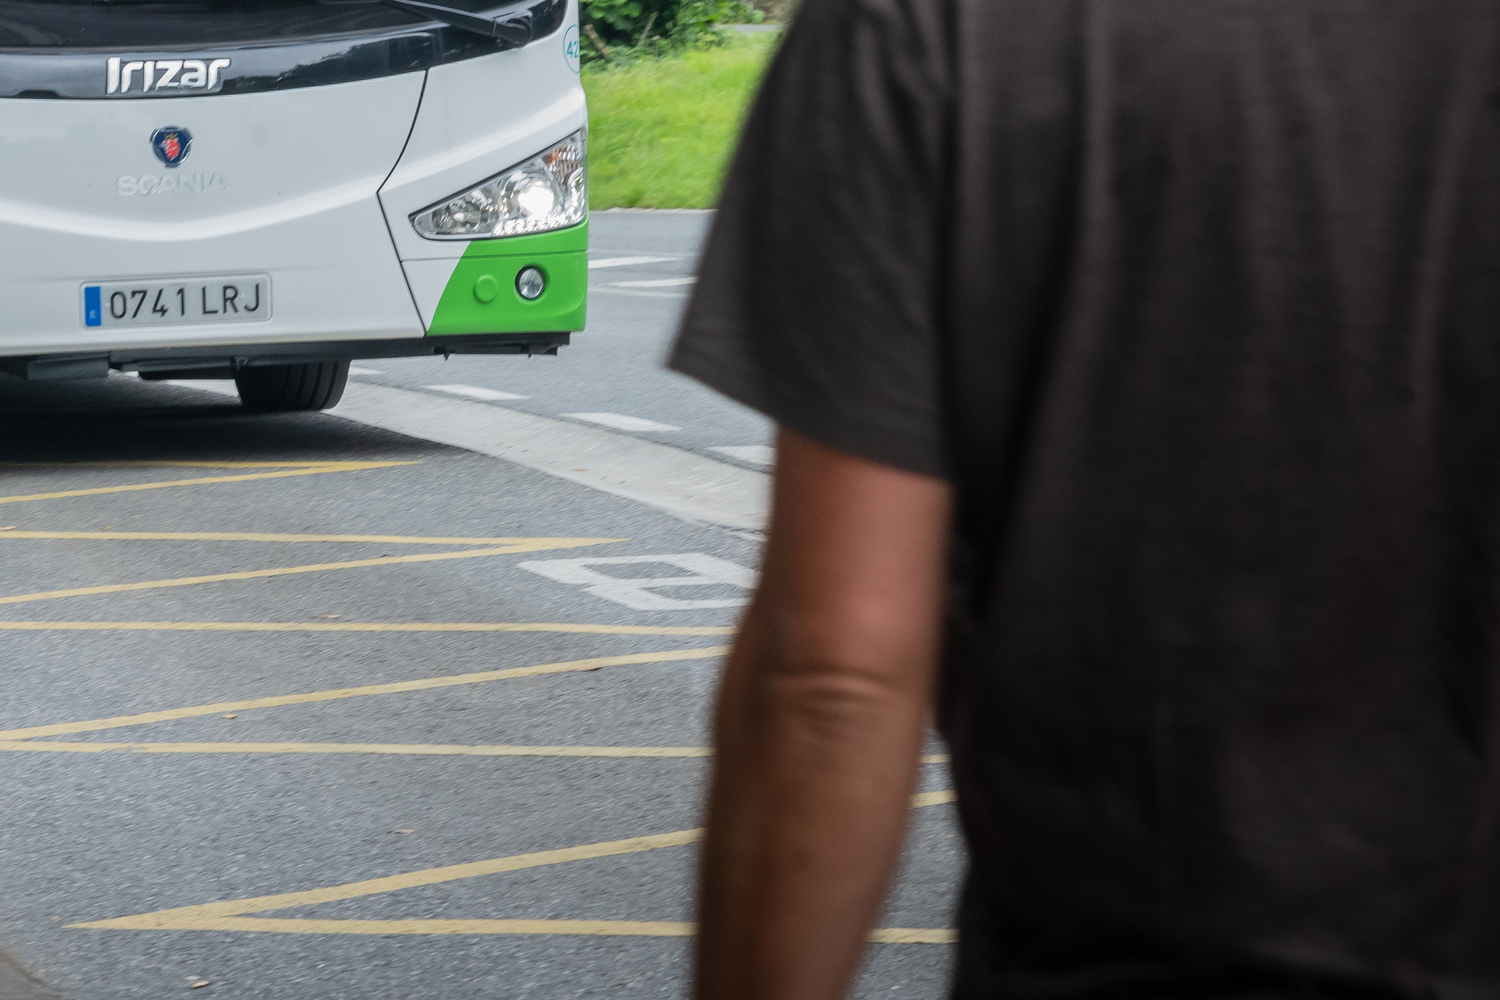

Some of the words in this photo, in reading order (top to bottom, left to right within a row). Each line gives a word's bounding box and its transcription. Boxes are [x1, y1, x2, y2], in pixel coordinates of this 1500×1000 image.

[566, 41, 580, 59] 42
[106, 56, 231, 95] Irizar
[116, 173, 228, 196] SCANIA
[109, 286, 186, 320] 0741
[201, 282, 262, 316] LRJ
